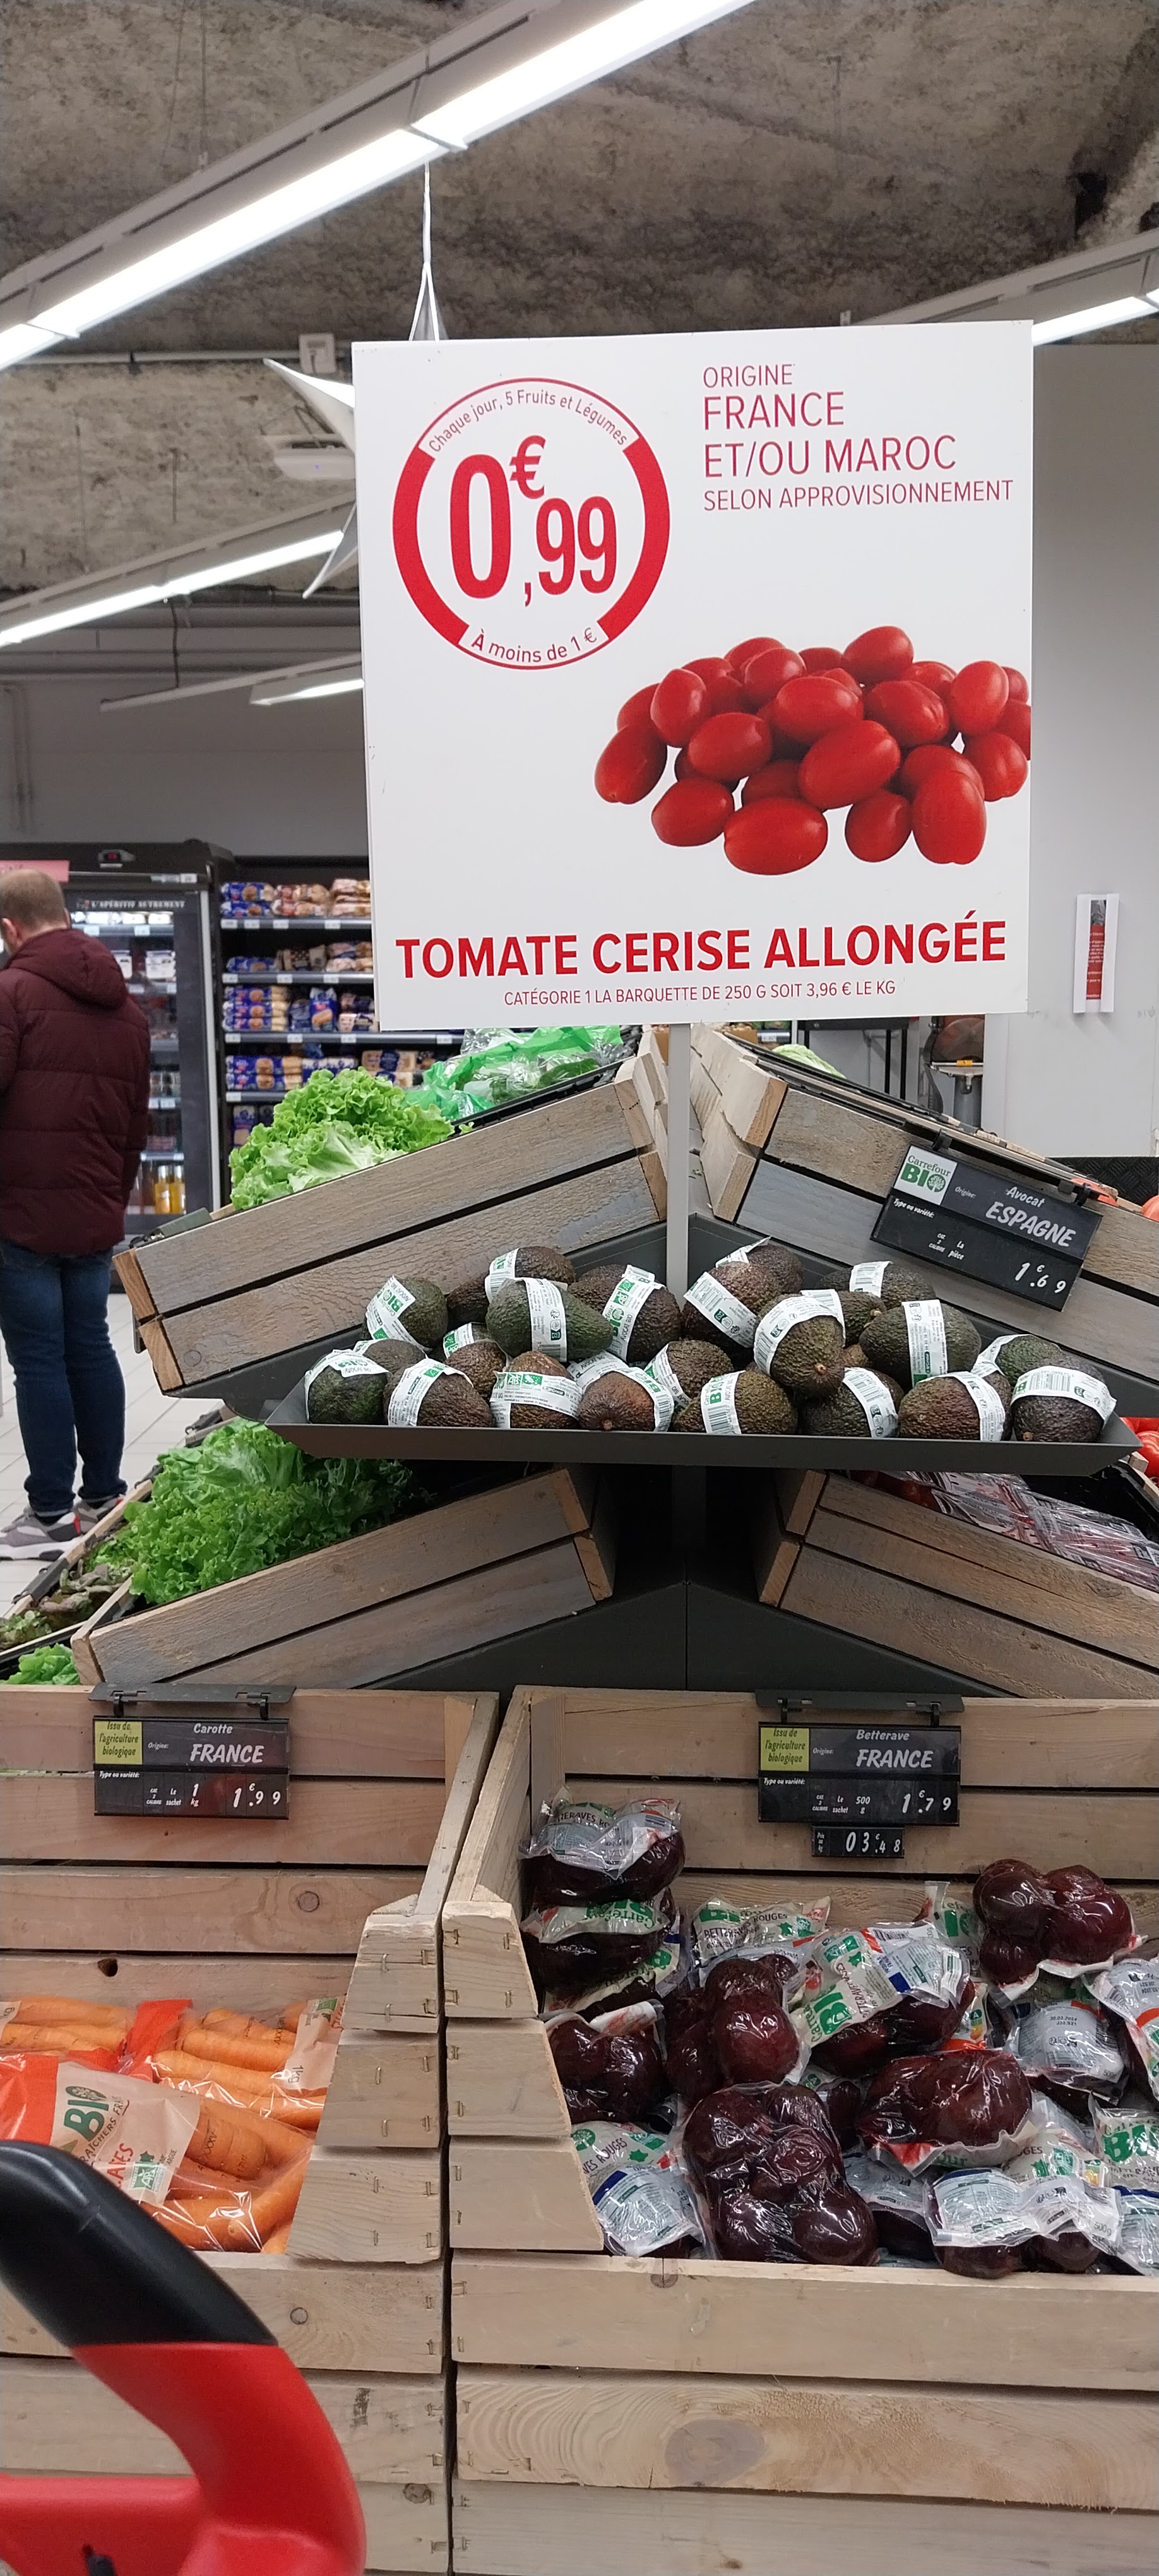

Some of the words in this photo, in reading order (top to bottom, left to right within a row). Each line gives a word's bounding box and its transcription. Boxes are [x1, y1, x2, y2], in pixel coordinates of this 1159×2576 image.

[703, 364, 793, 388] ORIGINE
[704, 391, 844, 430] FRANCE
[429, 411, 472, 452] Chaque
[471, 397, 503, 421] jour,
[506, 391, 513, 405] 5
[517, 390, 556, 405] Fruits
[560, 396, 573, 408] et
[576, 400, 627, 446] Légumes
[704, 440, 809, 477] ET/OU
[825, 435, 956, 473] MAROC
[704, 489, 771, 511] SELON
[779, 480, 1013, 508] APPROVISIONNEMENT
[471, 628, 484, 651] À
[488, 641, 542, 663] moins
[547, 644, 568, 661] de
[571, 636, 581, 651] 1
[583, 627, 597, 643] €
[395, 934, 578, 978] TOMATE
[593, 929, 750, 974] CERISE
[764, 910, 1006, 969] ALLONGÉE
[505, 988, 581, 1005] CATÉGORIE
[585, 990, 591, 1003] 1
[595, 989, 612, 1003] LA
[616, 987, 698, 1003] BARQUETTE
[703, 986, 720, 1000] DE
[725, 985, 751, 999] 250
[756, 985, 766, 998] G
[771, 983, 802, 998] SOIT
[806, 982, 837, 999] 3,96
[841, 982, 852, 996] €
[856, 981, 872, 995] LE
[877, 981, 896, 994] KG
[908, 1155, 951, 1177] Carrefour
[900, 1162, 946, 1193] BIO
[954, 1186, 977, 1199] Origine:
[1006, 1186, 1045, 1208] Avocat
[893, 1198, 906, 1207] Type
[914, 1207, 934, 1219] variété:
[985, 1201, 1076, 1247] ESPAGNE
[956, 1241, 965, 1249] La
[948, 1250, 965, 1260] pièce
[621, 1323, 629, 1342] AVOCAT
[193, 1723, 233, 1734] Carotte
[856, 1729, 910, 1741] Betterave
[99, 1733, 139, 1744] l'agriculture
[148, 1742, 169, 1750] Origine:
[765, 1739, 805, 1751] l'agriculture
[102, 1745, 136, 1758] biologique
[190, 1744, 264, 1763] FRANCE
[768, 1753, 803, 1764] biologique
[812, 1748, 834, 1756] Origine:
[856, 1749, 933, 1768] FRANCE
[99, 1770, 111, 1779] Type
[193, 1783, 199, 1797] 1
[191, 1798, 199, 1807] kg
[856, 1796, 871, 1804] 500
[754, 1912, 788, 1924] ROUGES
[64, 2086, 109, 2142] BIO
[597, 2138, 627, 2164] ROUGES
[1093, 2223, 1112, 2236] 500g
